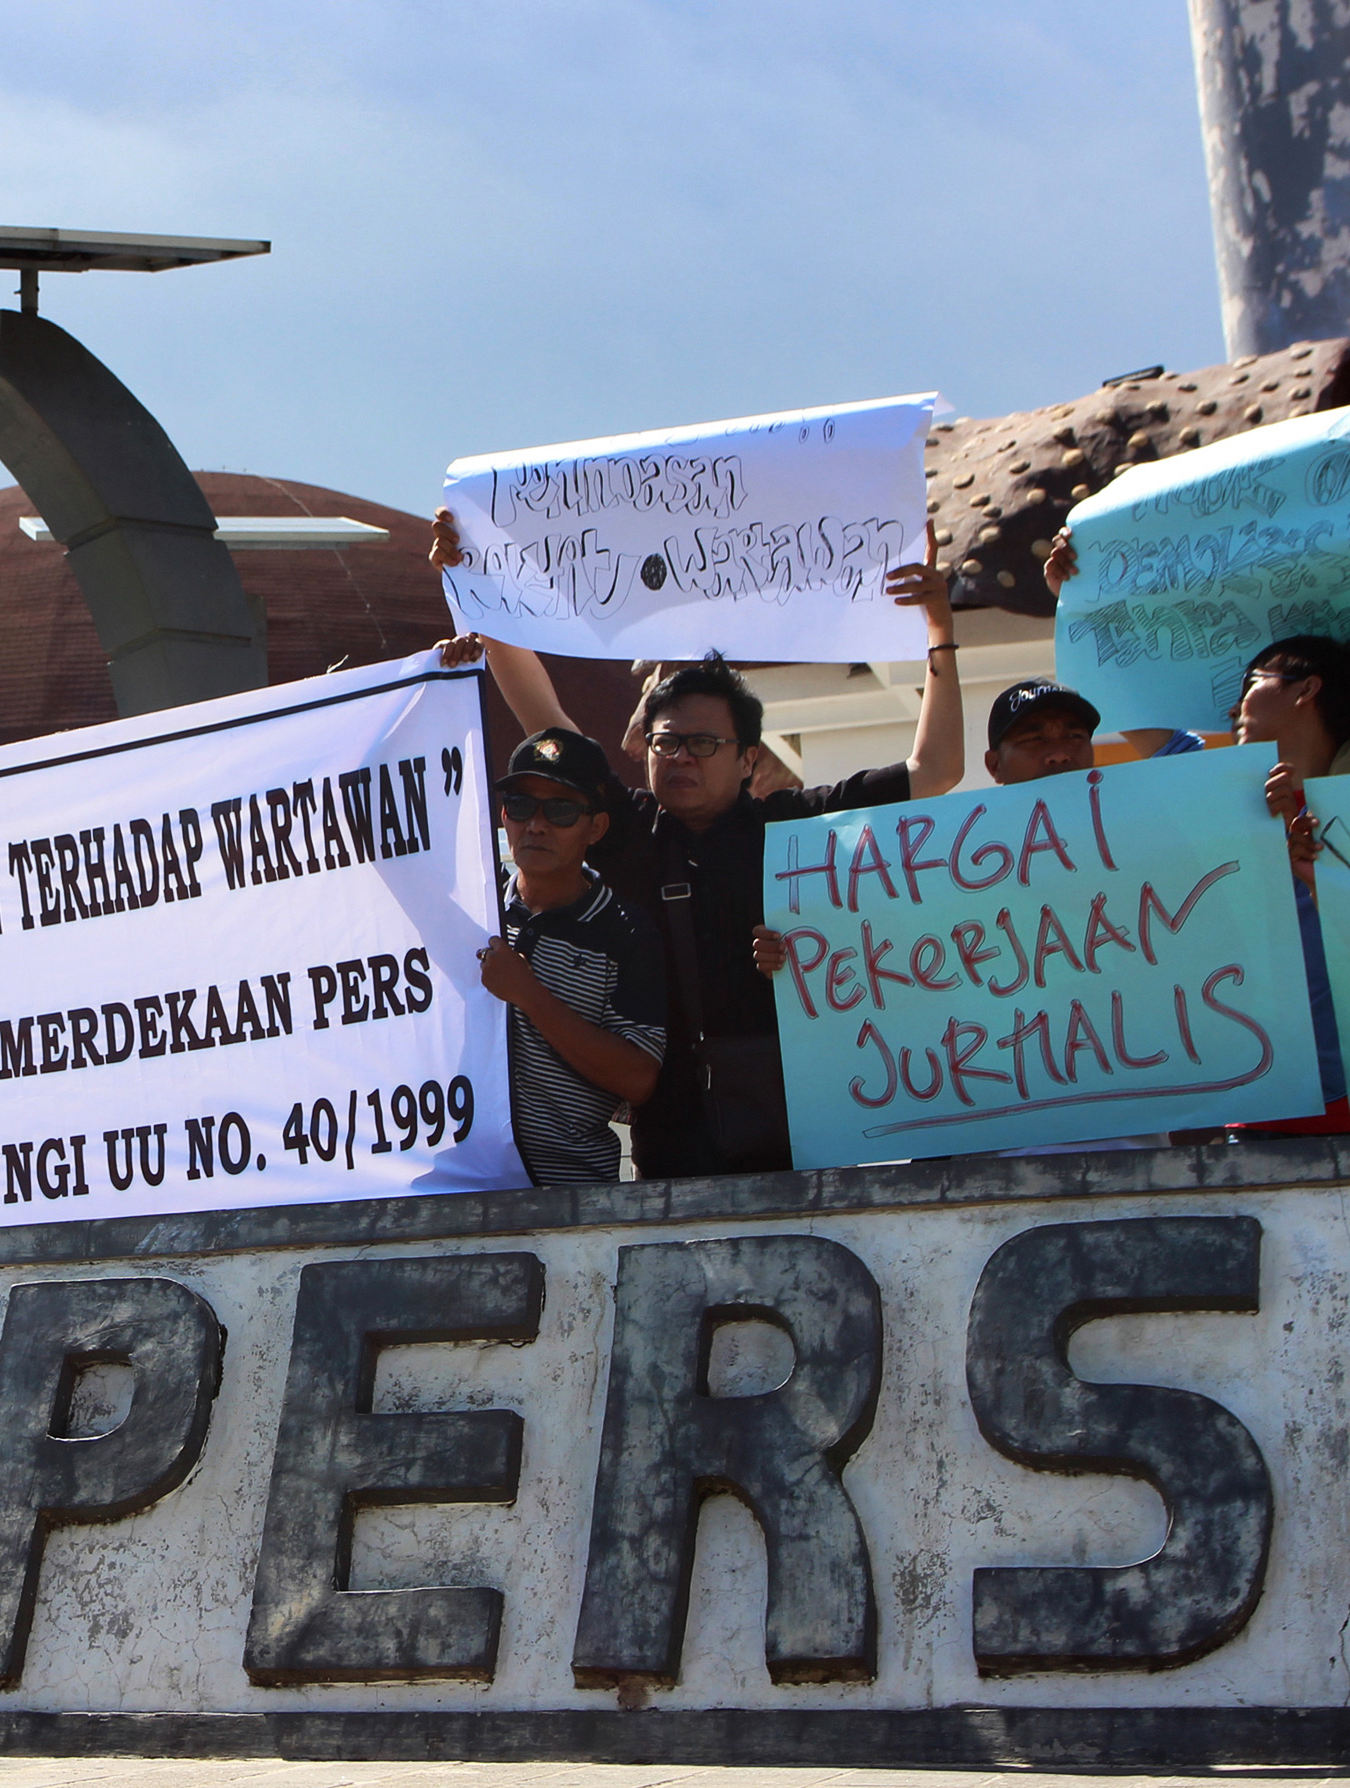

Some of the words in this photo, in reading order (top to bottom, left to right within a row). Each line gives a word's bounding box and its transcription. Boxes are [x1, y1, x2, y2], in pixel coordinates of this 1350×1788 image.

[8, 807, 203, 931] TERHADAP
[211, 756, 432, 891] WARTAWAN
[307, 946, 434, 1030] PERS
[103, 1122, 168, 1192] UU
[185, 1110, 267, 1180] NO.
[282, 1074, 475, 1170] 40/1999
